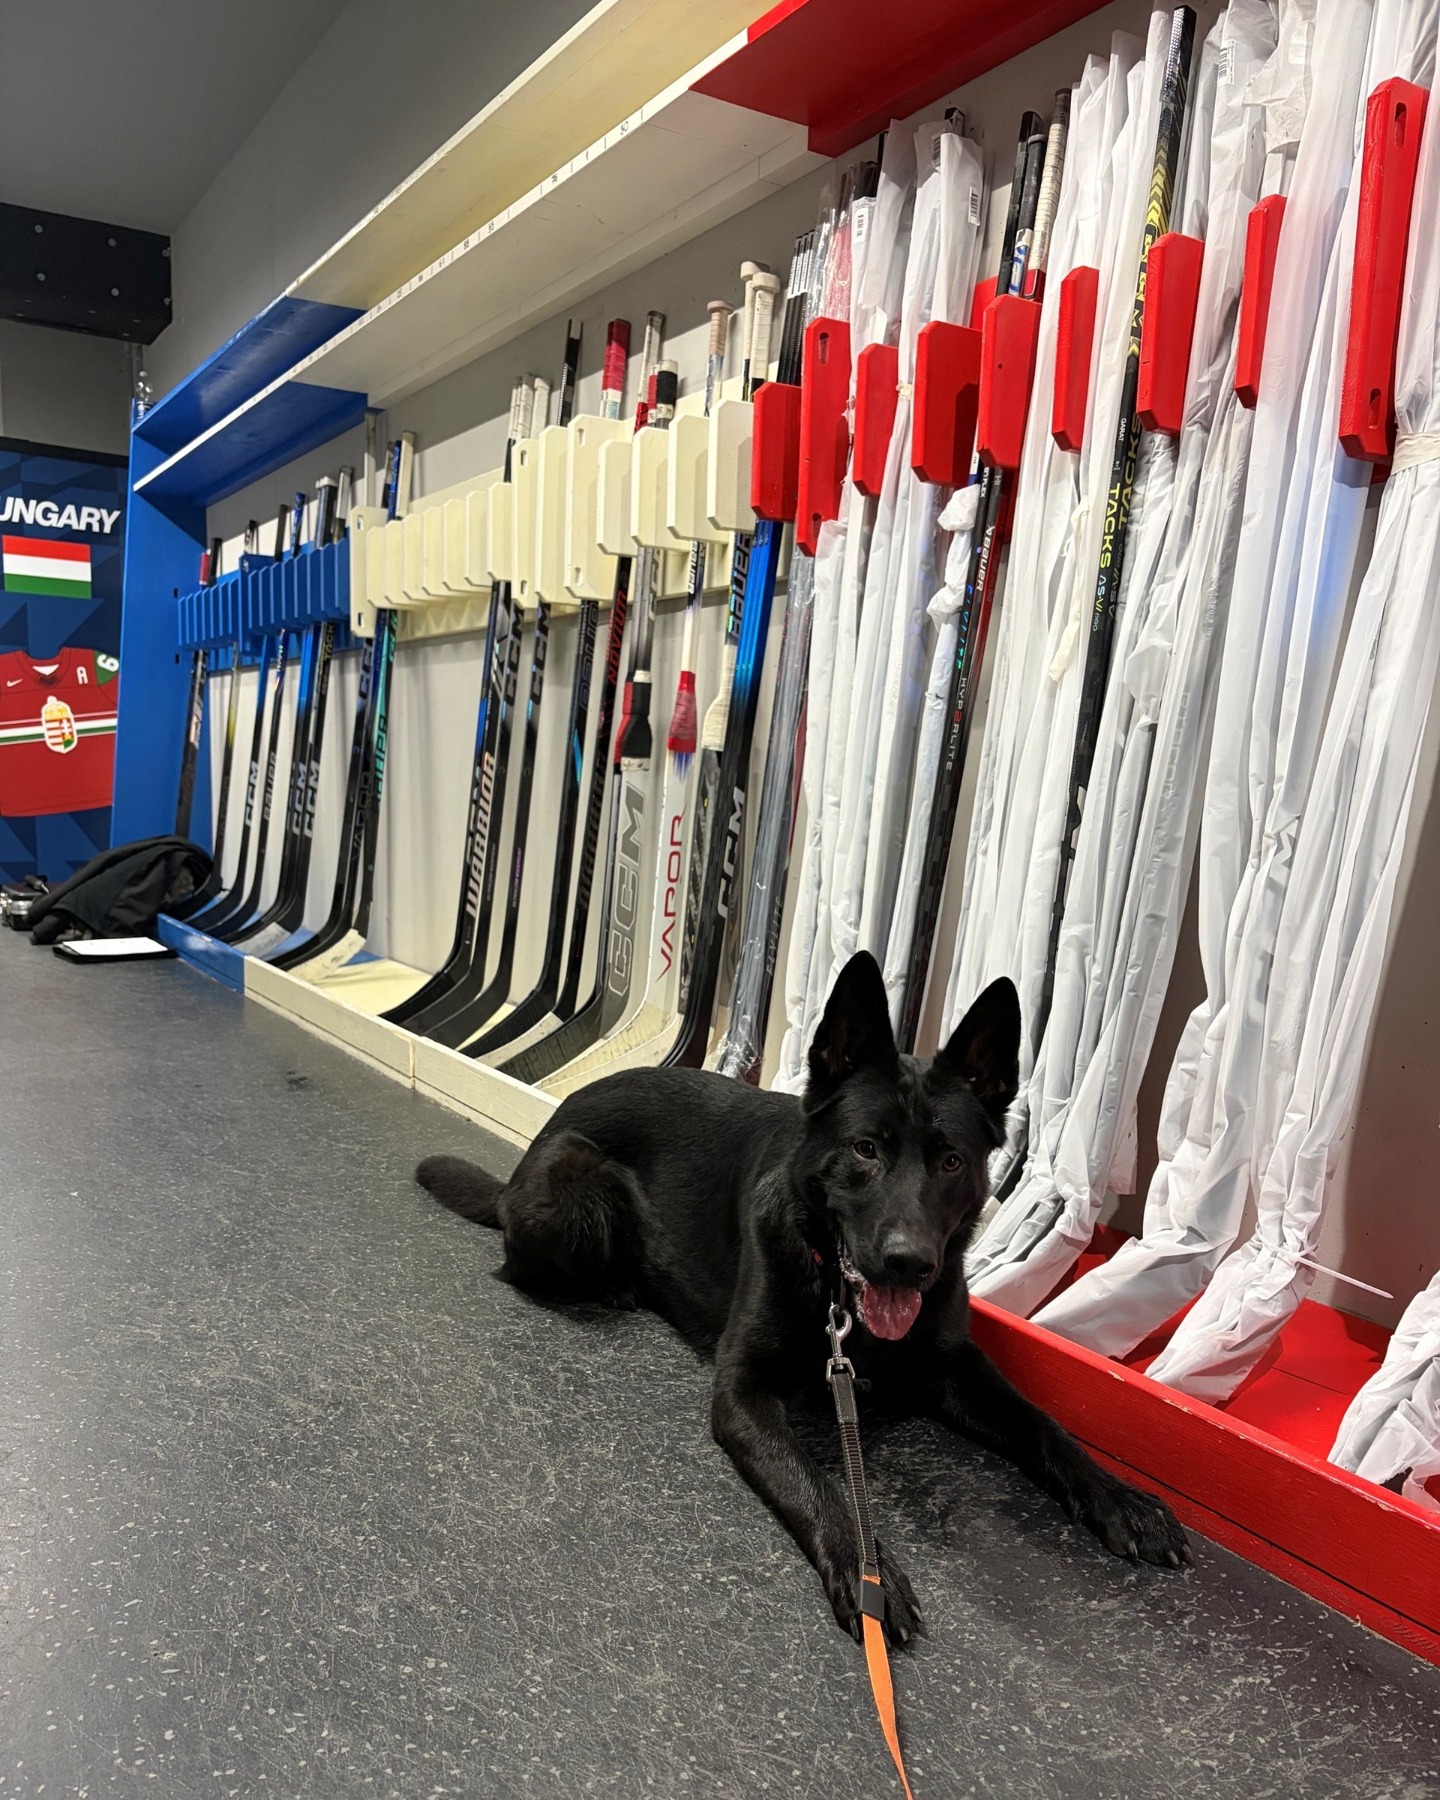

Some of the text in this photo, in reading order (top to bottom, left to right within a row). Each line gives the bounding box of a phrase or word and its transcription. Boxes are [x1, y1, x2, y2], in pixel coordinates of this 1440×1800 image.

[980, 477, 988, 498] FLEX
[1100, 483, 1120, 569] TACKS
[977, 535, 992, 592] BAUER
[76, 666, 88, 685] A
[607, 590, 628, 686] NOVIUM
[245, 760, 259, 828] CCM
[293, 761, 307, 836] CCM
[304, 759, 320, 839] CCM
[466, 751, 496, 918] WARRIOR
[609, 780, 646, 999] CCM
[655, 801, 687, 983] VAPOR
[717, 786, 745, 920] CCM
